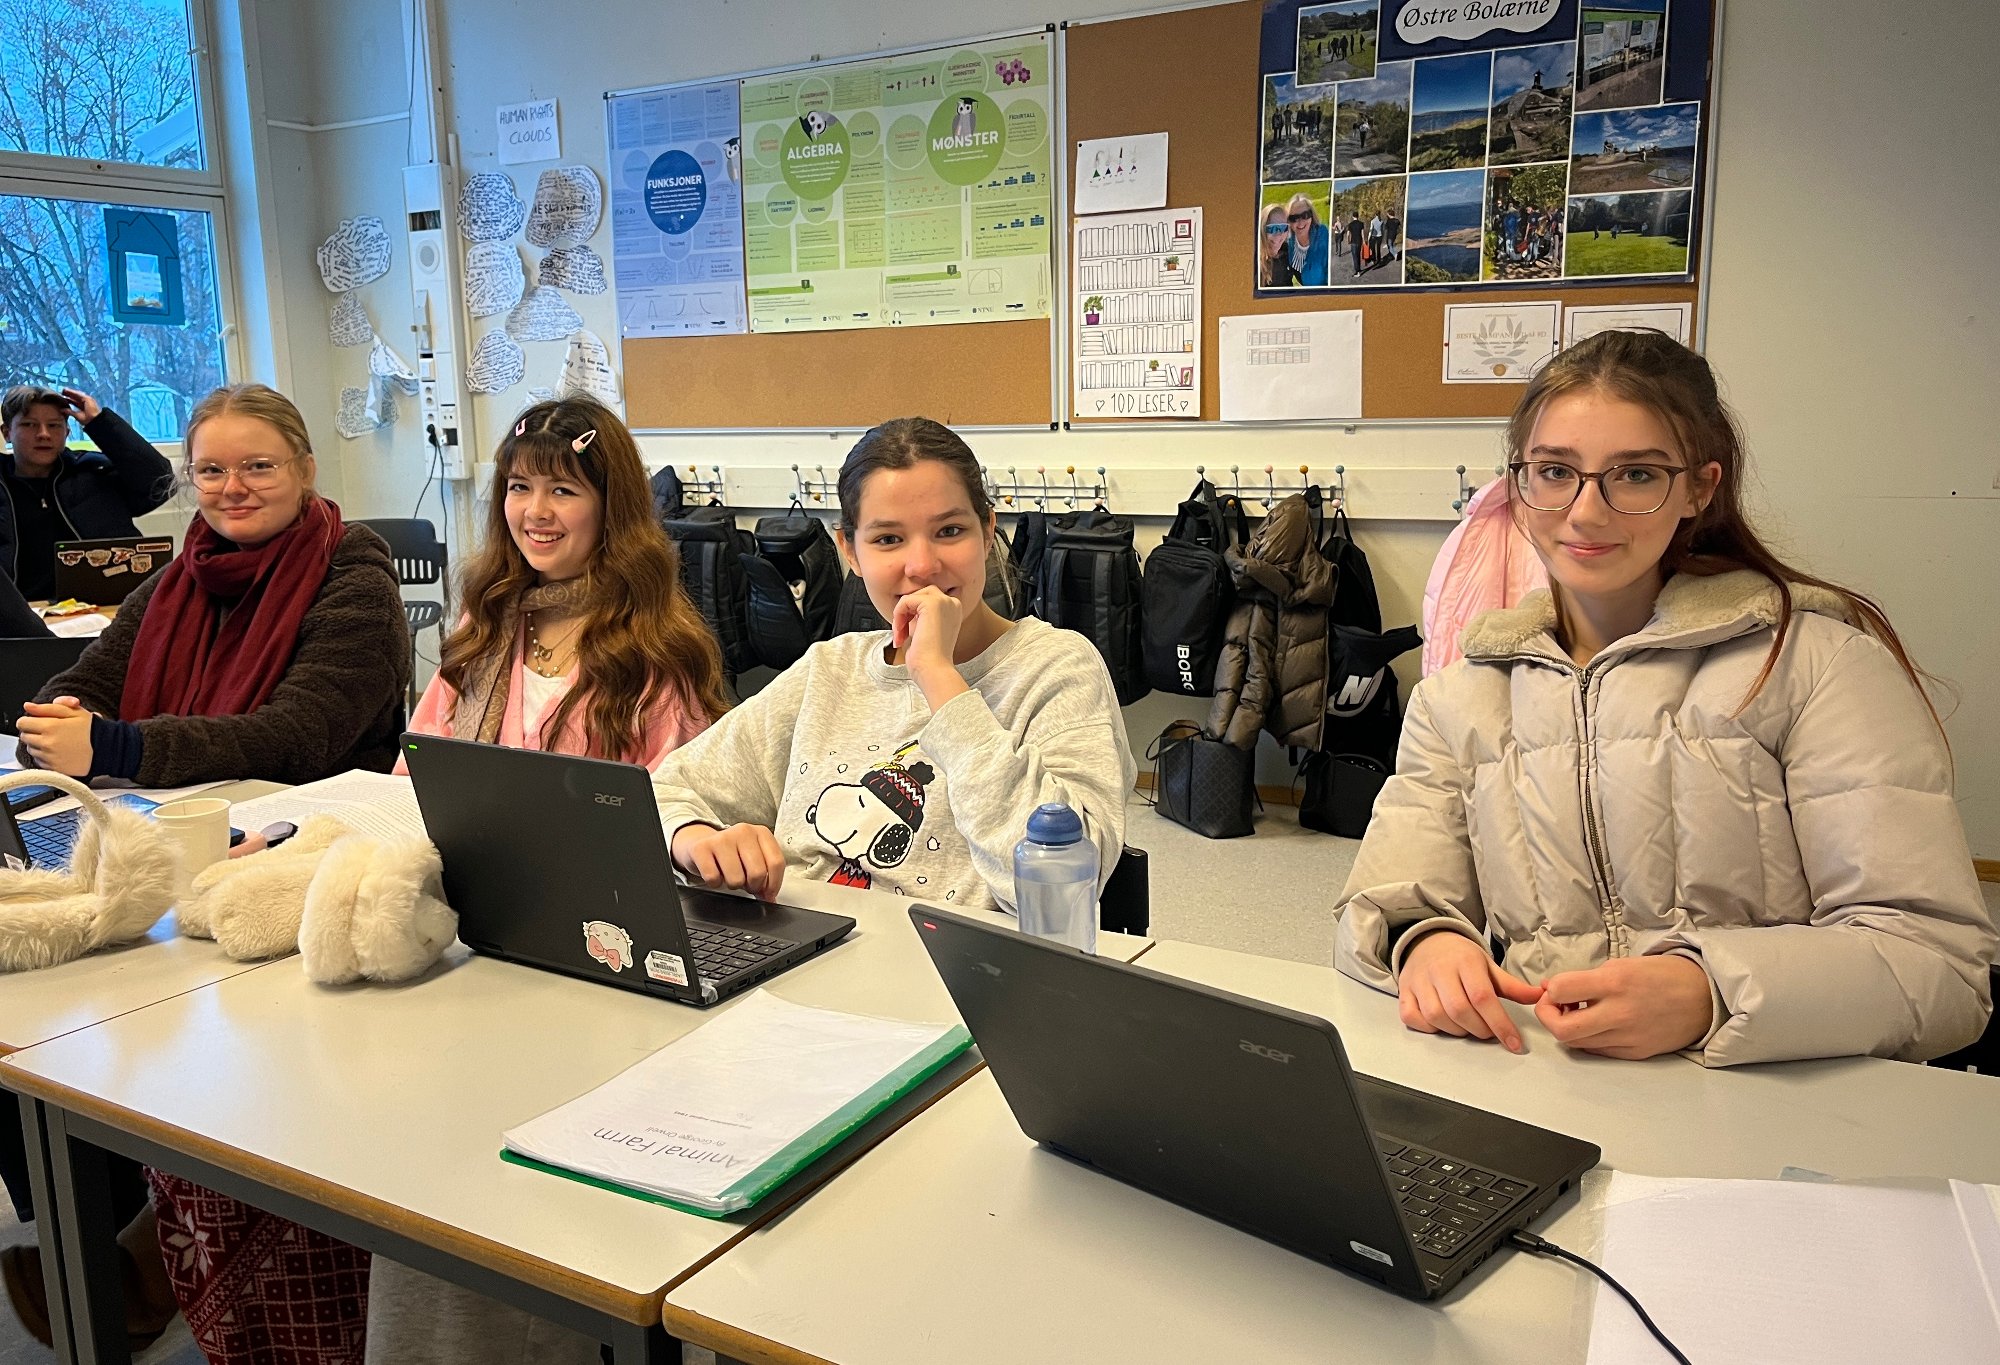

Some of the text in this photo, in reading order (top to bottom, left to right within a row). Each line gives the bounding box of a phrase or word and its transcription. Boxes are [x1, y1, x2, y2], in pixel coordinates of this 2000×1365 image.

[1403, 0, 1550, 29] Østre Bolærne
[499, 103, 554, 125] HUMAN RIGHTS
[509, 127, 552, 145] CLOUDS
[932, 130, 999, 151] MØNSTER
[787, 142, 843, 160] ALGEBRA
[647, 174, 702, 189] FUNKSJONER
[1138, 393, 1177, 413] LESER
[594, 792, 626, 807] acer
[1239, 1039, 1297, 1064] acer
[644, 1126, 678, 1138] Orwell
[677, 1133, 713, 1146] George
[593, 1127, 747, 1169] Animal Farm
